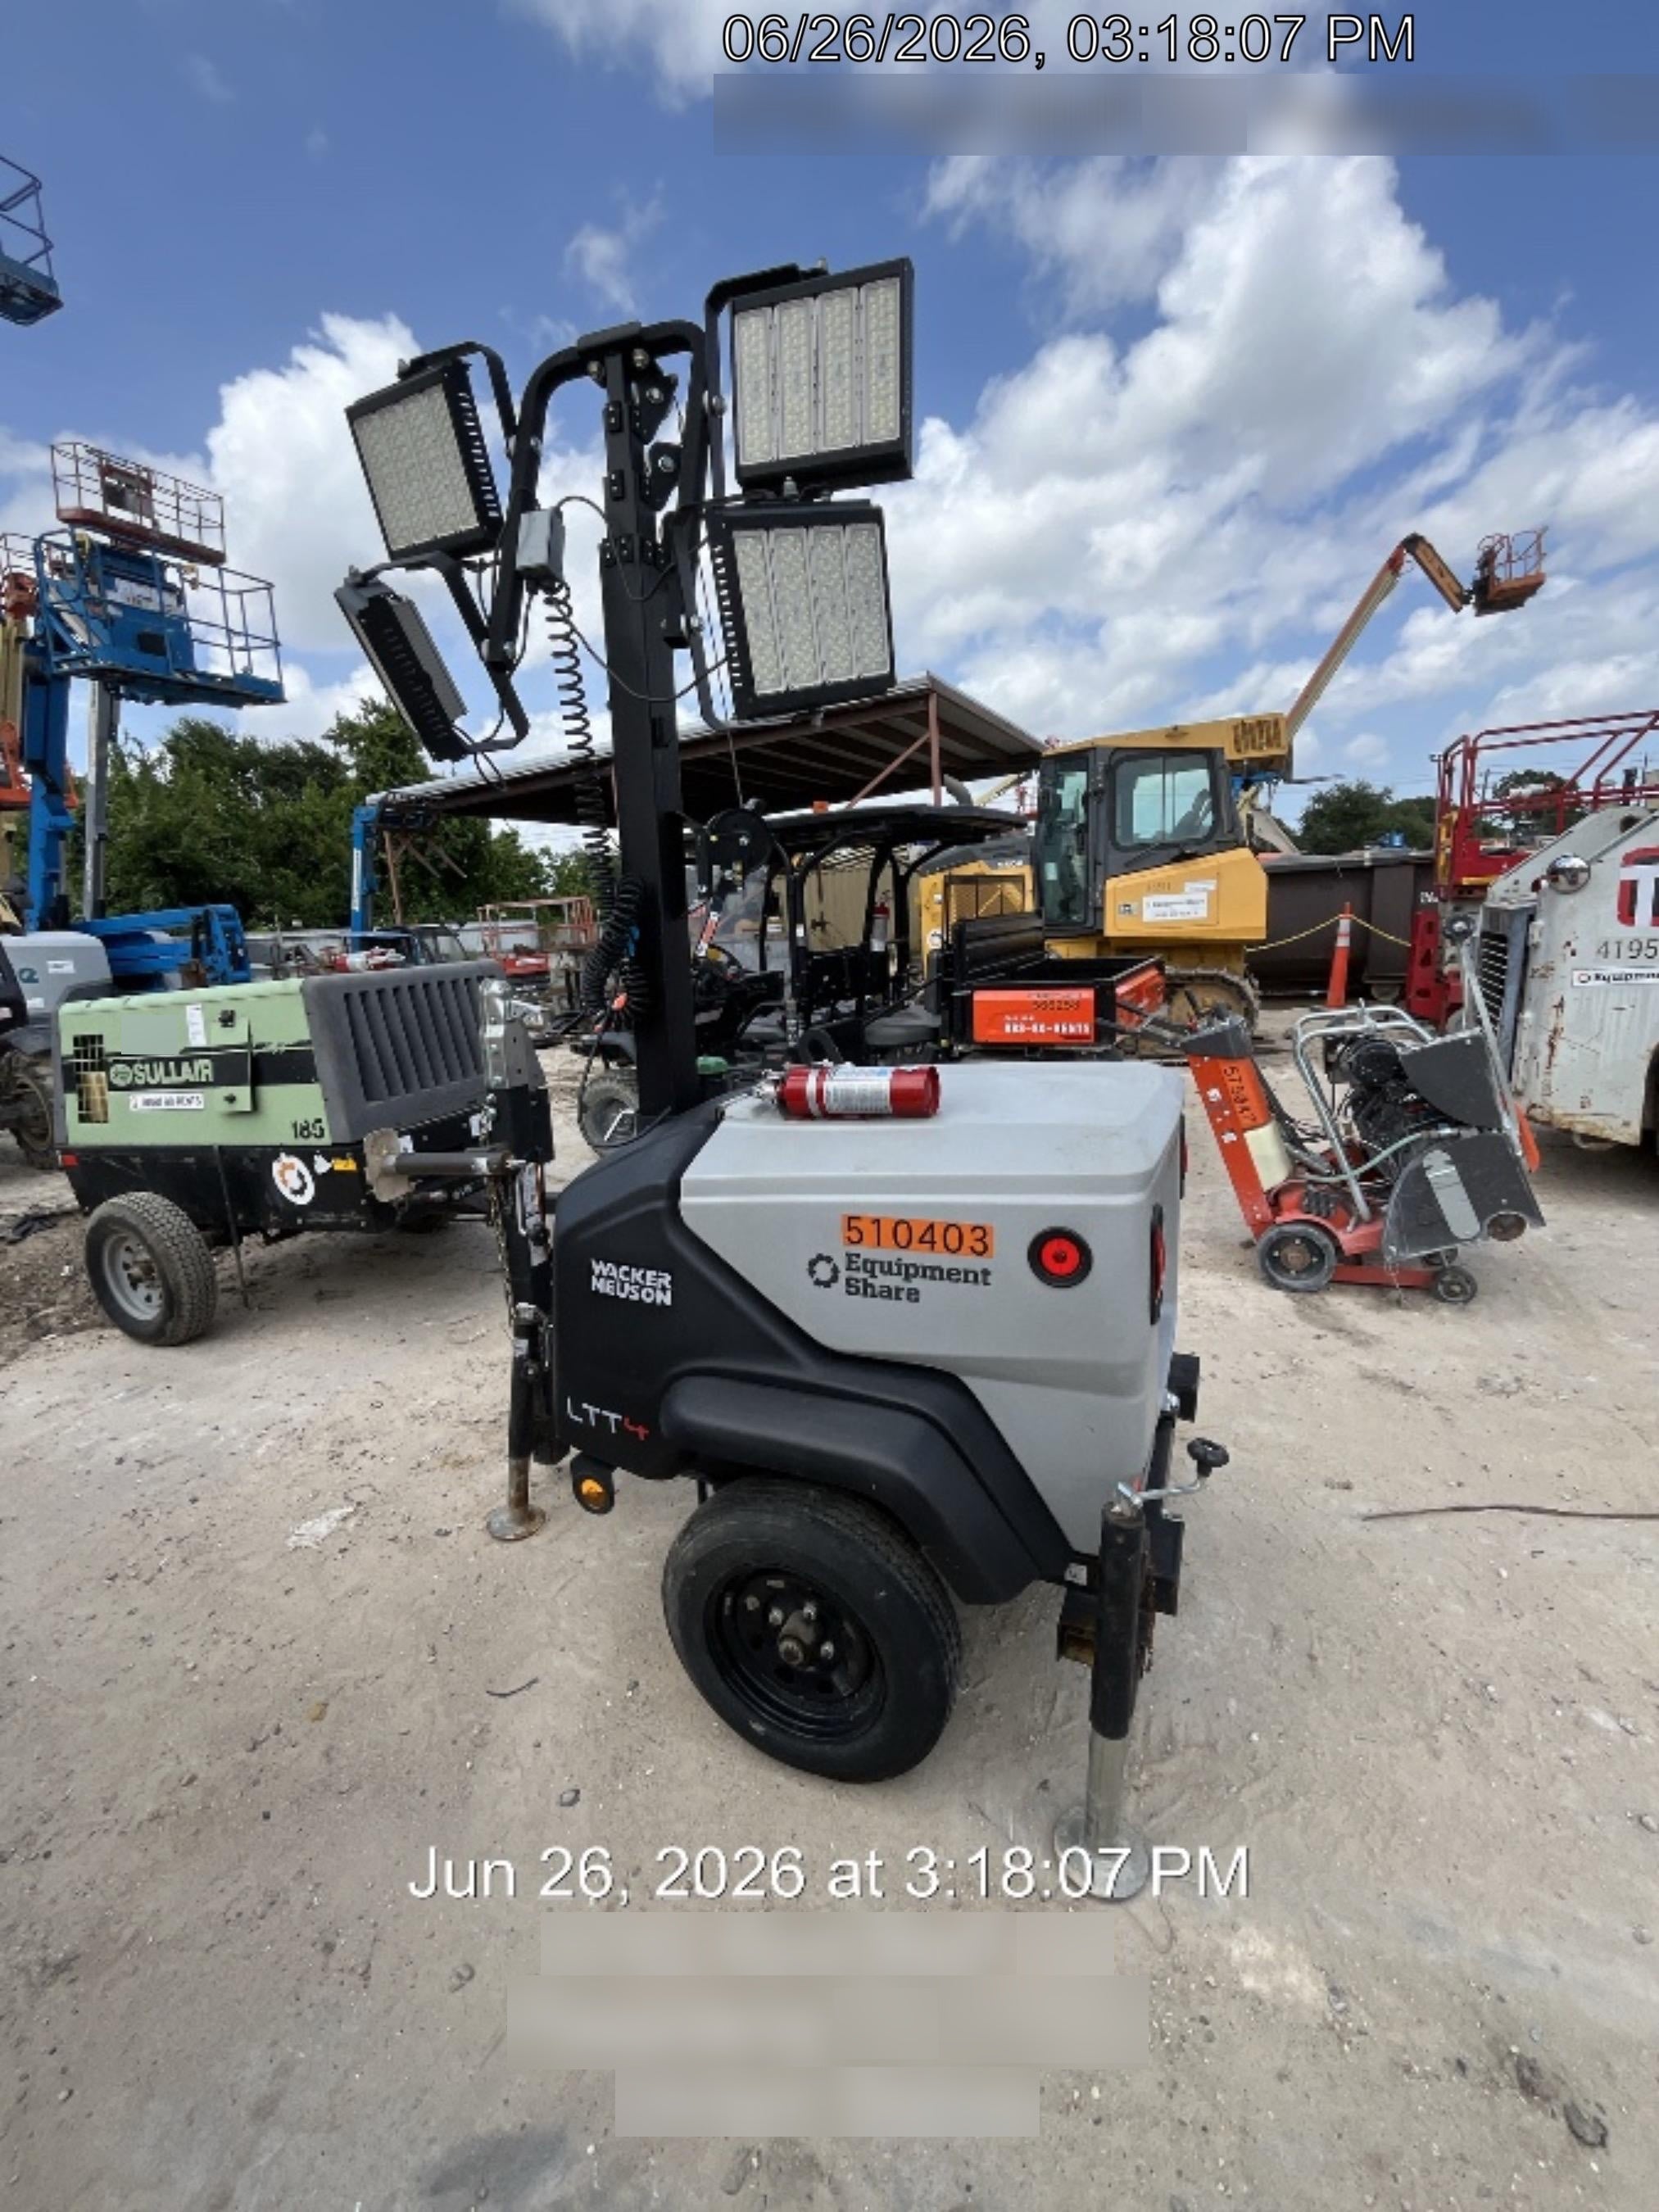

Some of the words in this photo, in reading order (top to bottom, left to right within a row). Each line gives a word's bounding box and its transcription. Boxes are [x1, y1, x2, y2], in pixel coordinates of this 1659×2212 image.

[133, 1058, 213, 1085] SULLAIR
[292, 1118, 325, 1140] 185
[845, 1216, 989, 1256] 510403
[591, 1258, 672, 1290] WACKER
[845, 1251, 992, 1286] Equipment
[591, 1274, 672, 1307] NEUSON
[845, 1276, 920, 1303] Share
[566, 1395, 650, 1441] LTT4
